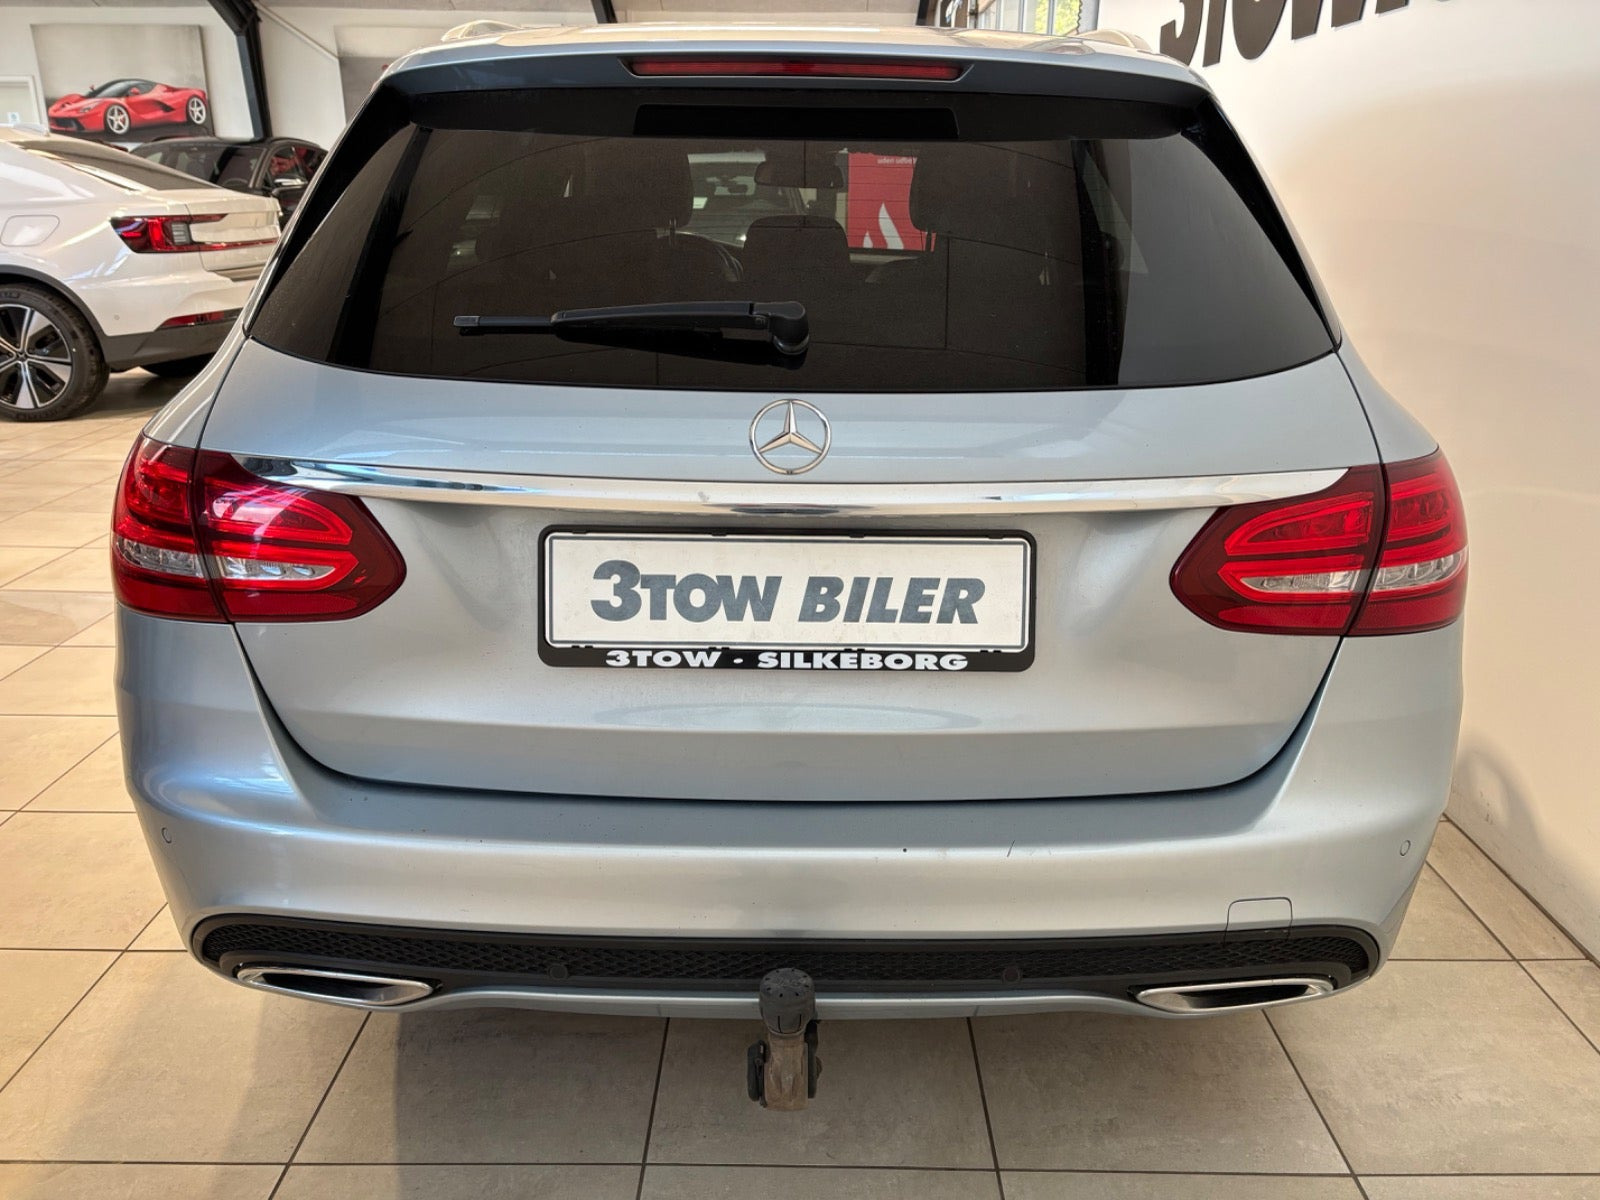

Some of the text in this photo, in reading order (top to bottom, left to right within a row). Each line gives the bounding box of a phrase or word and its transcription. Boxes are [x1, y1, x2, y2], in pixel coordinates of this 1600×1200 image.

[591, 560, 985, 624] 3TOW BILER
[605, 650, 968, 670] 3TOW SILKEBORG
